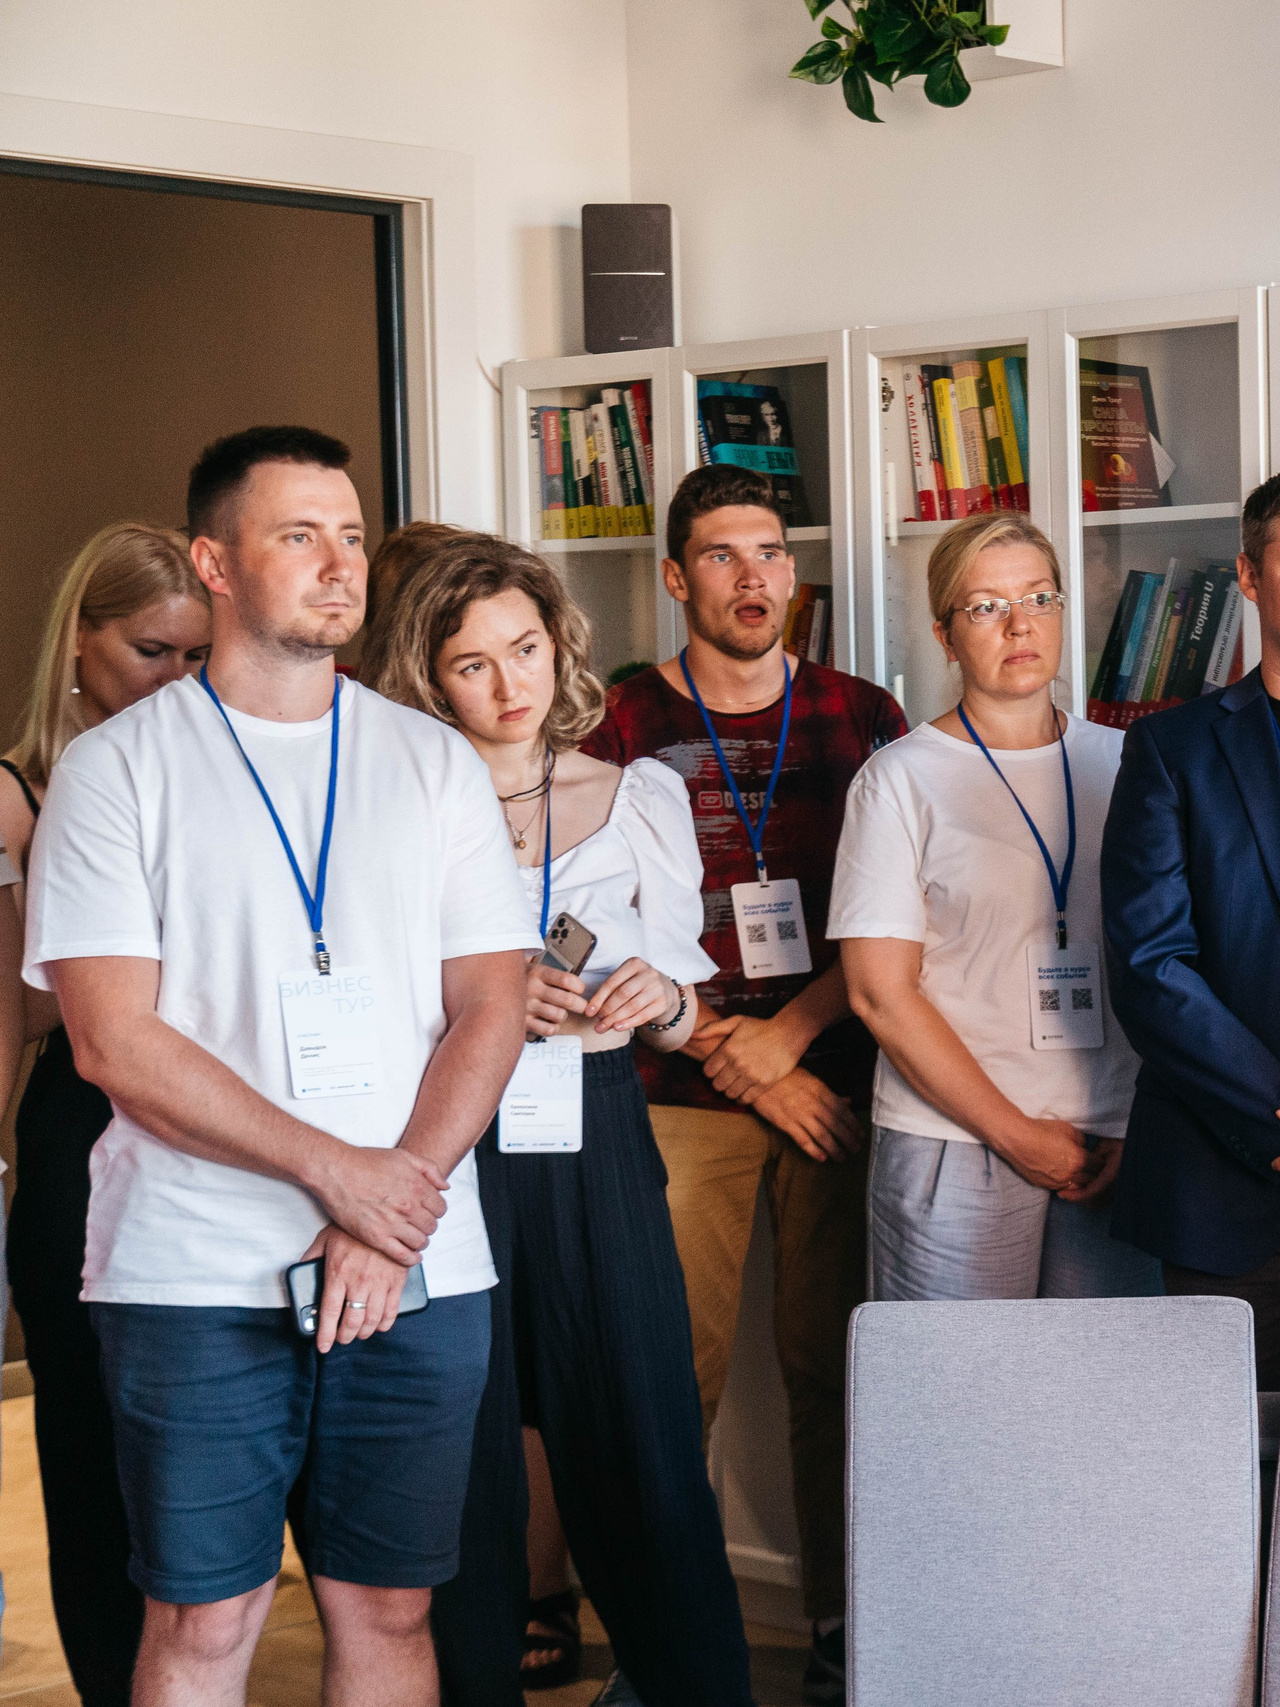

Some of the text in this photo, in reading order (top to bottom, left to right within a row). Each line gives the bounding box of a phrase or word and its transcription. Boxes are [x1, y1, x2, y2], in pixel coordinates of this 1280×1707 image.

[1190, 593, 1212, 641] Теория
[1204, 581, 1214, 592] U
[724, 791, 778, 809] DESEL
[280, 975, 373, 999] БИЗНЕС
[334, 996, 375, 1014] ТУР
[545, 1063, 583, 1079] ТУР
